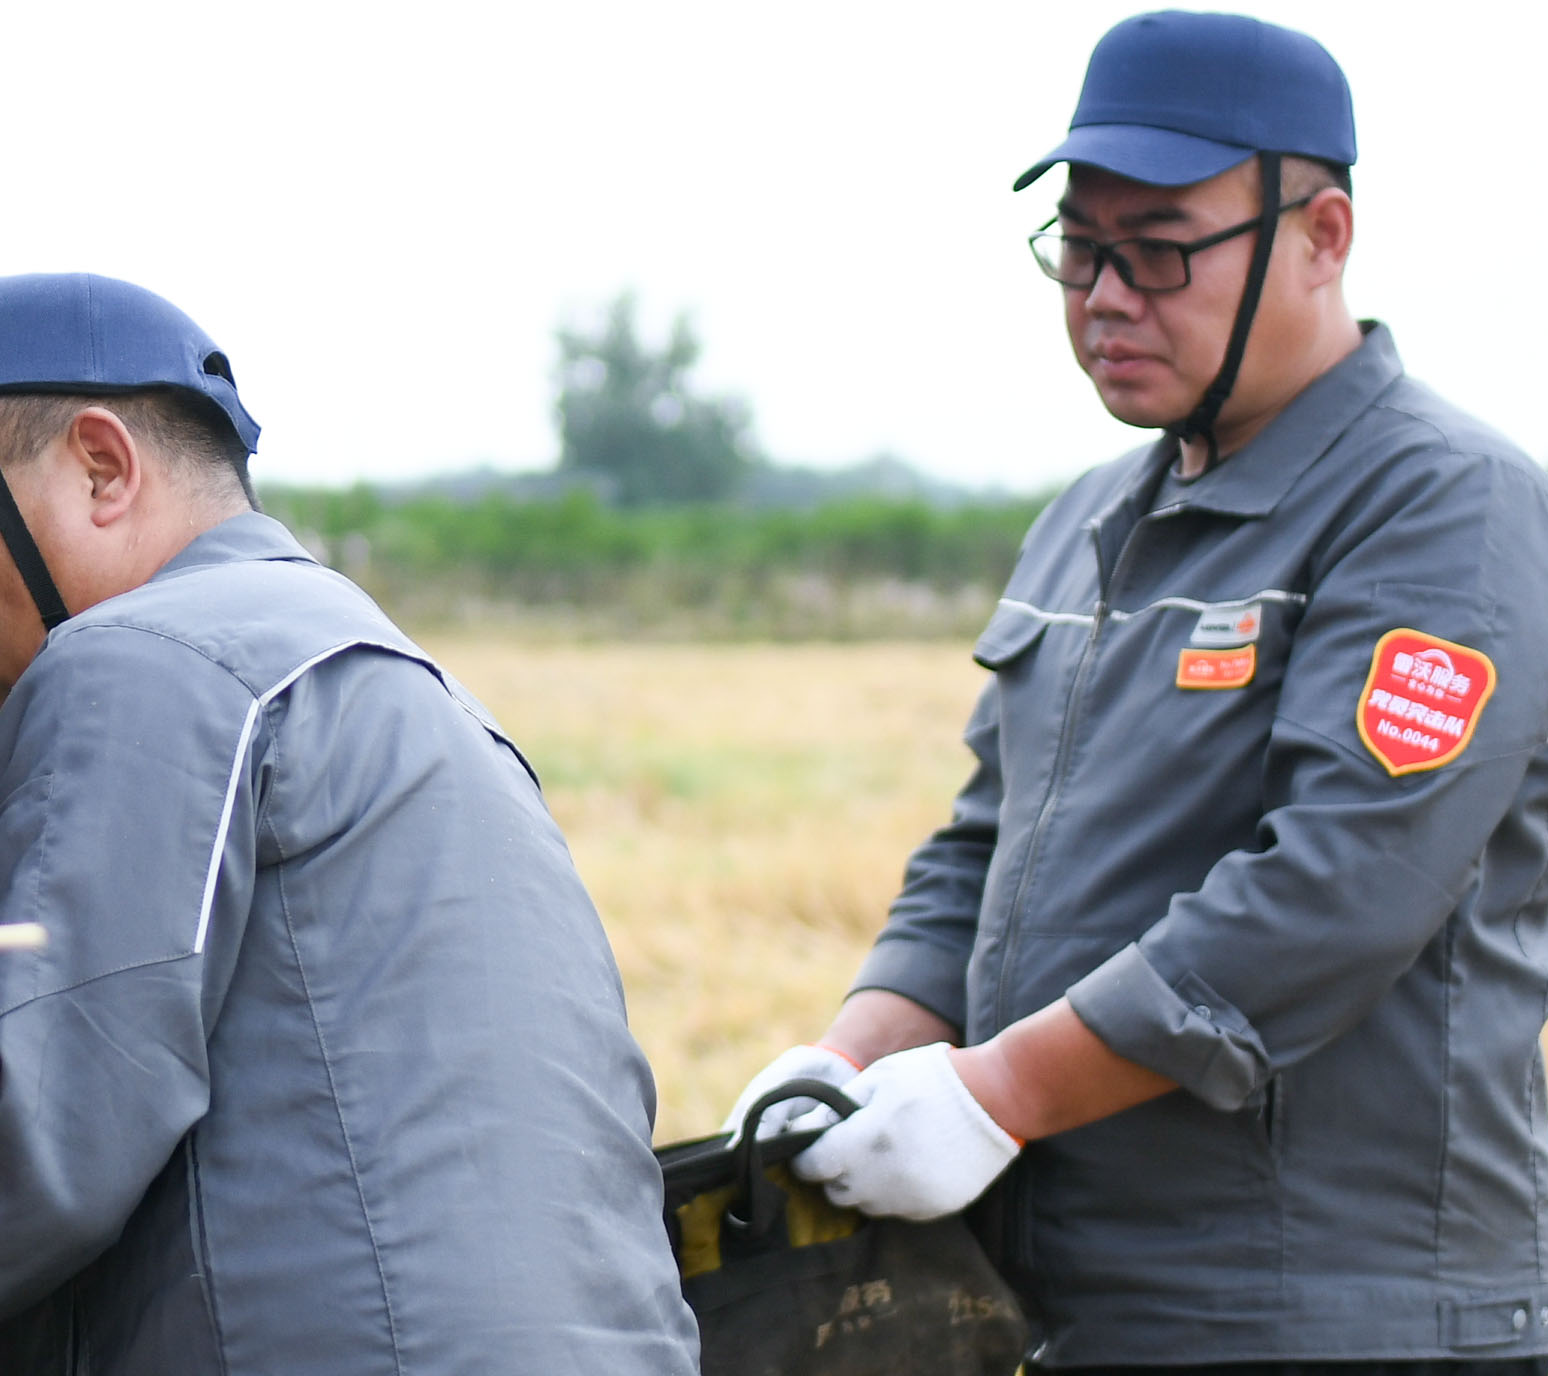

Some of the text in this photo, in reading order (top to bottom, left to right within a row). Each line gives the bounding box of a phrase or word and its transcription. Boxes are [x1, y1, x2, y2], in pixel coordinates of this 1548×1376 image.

[1391, 651, 1472, 696] 雷沃服务
[1376, 718, 1441, 753] No.0044
